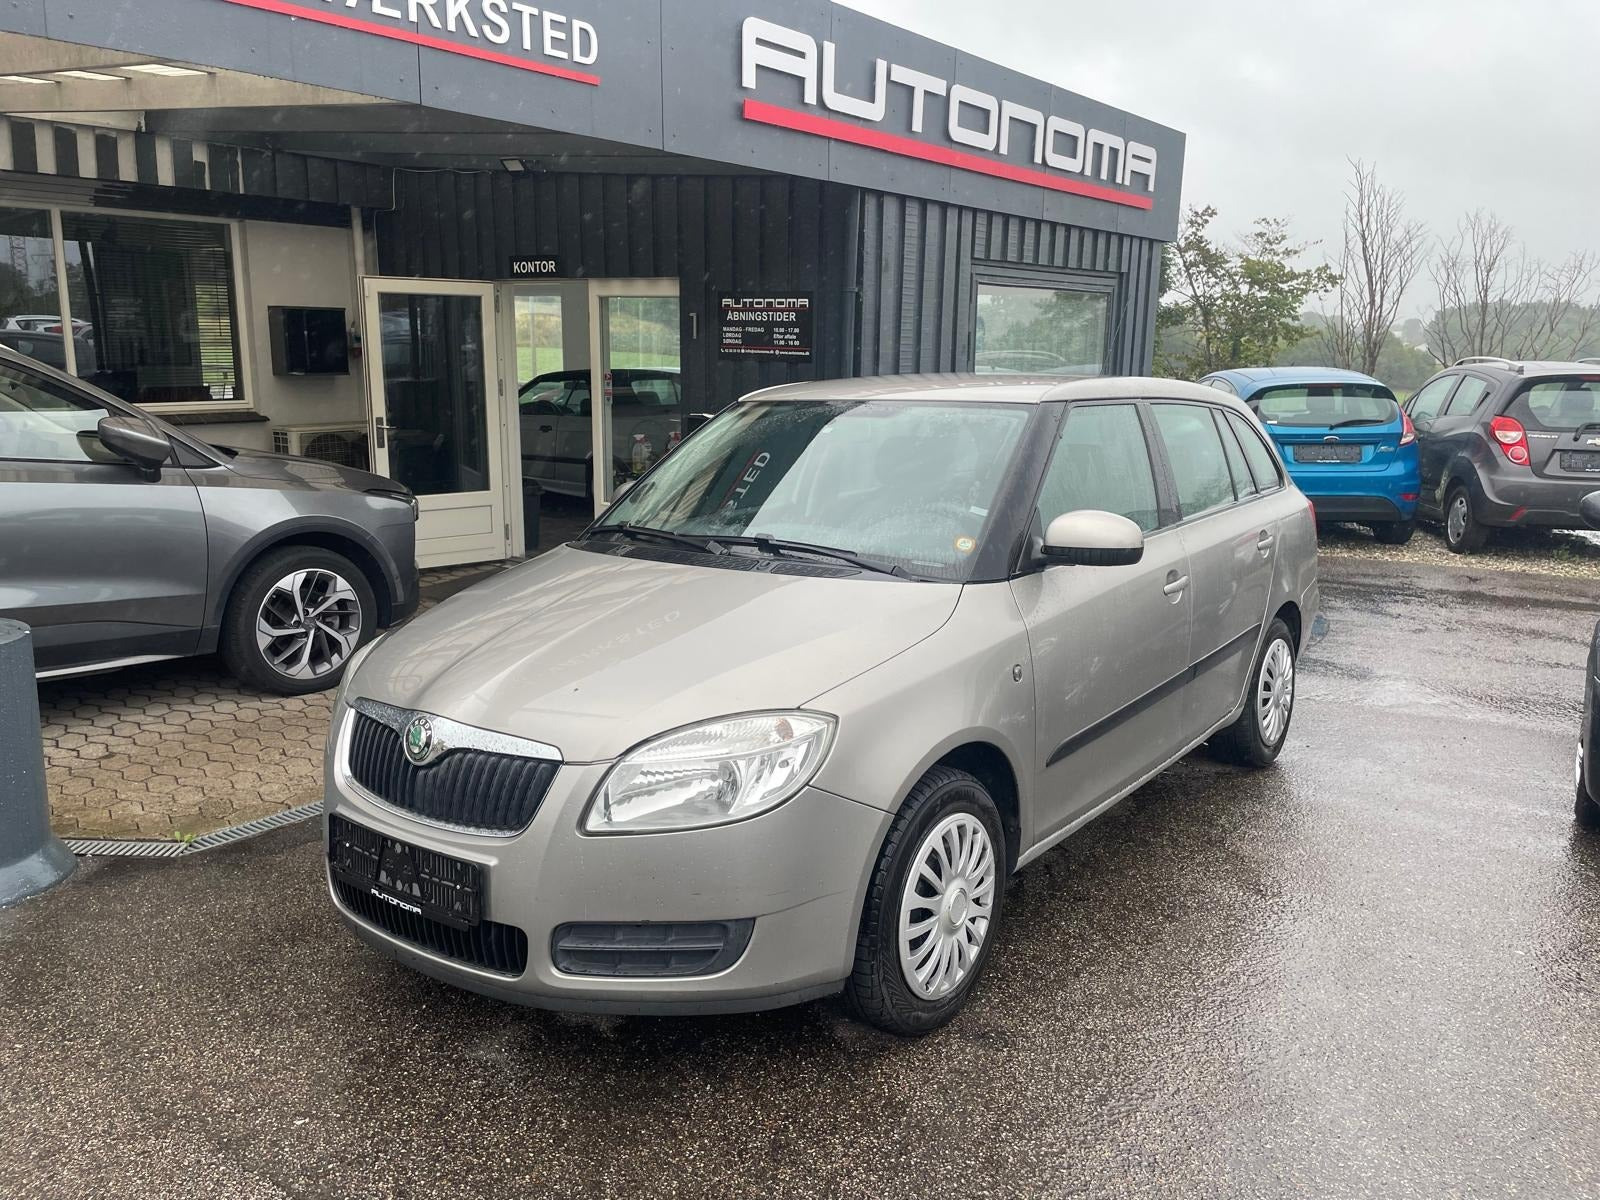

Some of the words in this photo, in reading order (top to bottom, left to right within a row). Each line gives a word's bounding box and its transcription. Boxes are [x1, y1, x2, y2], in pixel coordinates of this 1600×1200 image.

[741, 16, 1158, 192] AUTONOMA
[513, 260, 557, 274] KONTOR
[722, 299, 809, 308] AUTONOMA
[727, 310, 796, 322] ÅBNINGSTIDER
[370, 888, 422, 915] AUTONOMA
